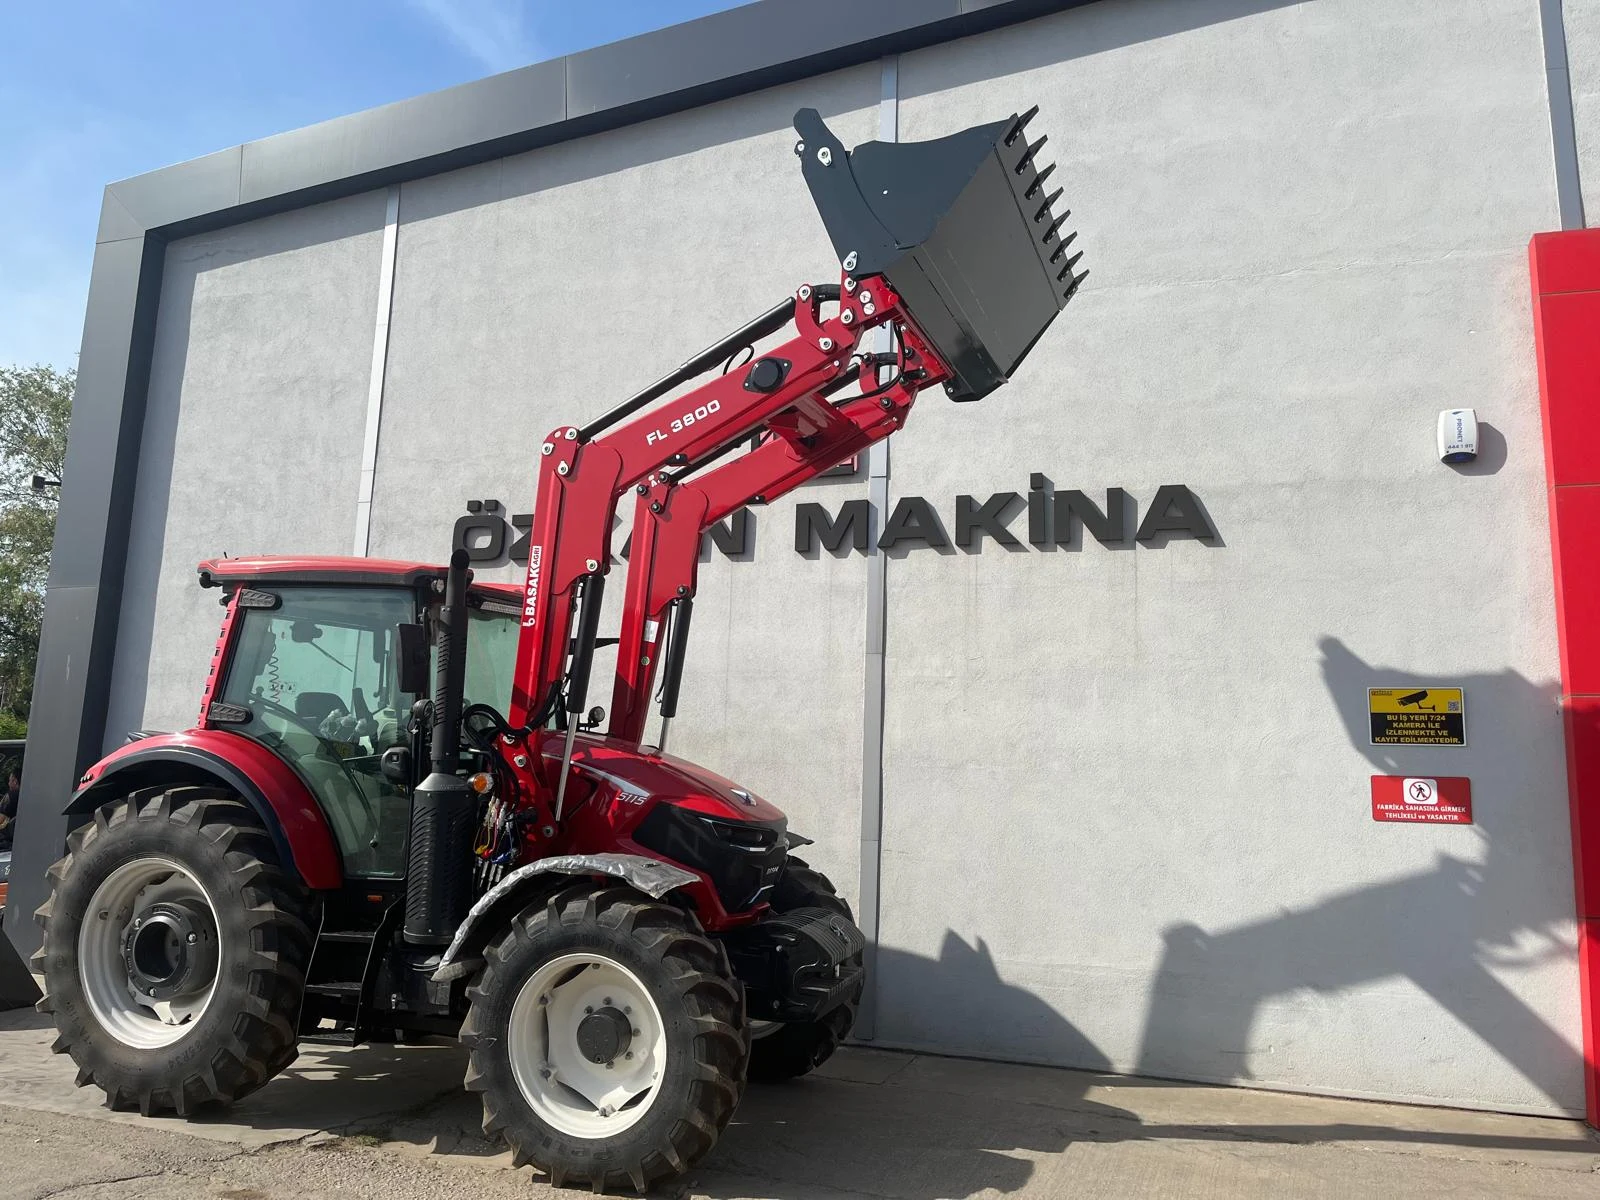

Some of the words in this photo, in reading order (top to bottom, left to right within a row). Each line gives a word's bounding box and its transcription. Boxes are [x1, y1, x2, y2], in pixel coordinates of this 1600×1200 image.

[646, 429, 669, 446] FL
[670, 399, 721, 433] 3800
[1456, 418, 1464, 443] PRONET
[795, 472, 1214, 551] MAKİNA
[1427, 721, 1441, 729] İLE
[615, 792, 647, 806] 5115
[1376, 803, 1405, 811] FABRİKA
[1405, 804, 1440, 812] SAHASINA
[1440, 805, 1466, 813] GİRMEK
